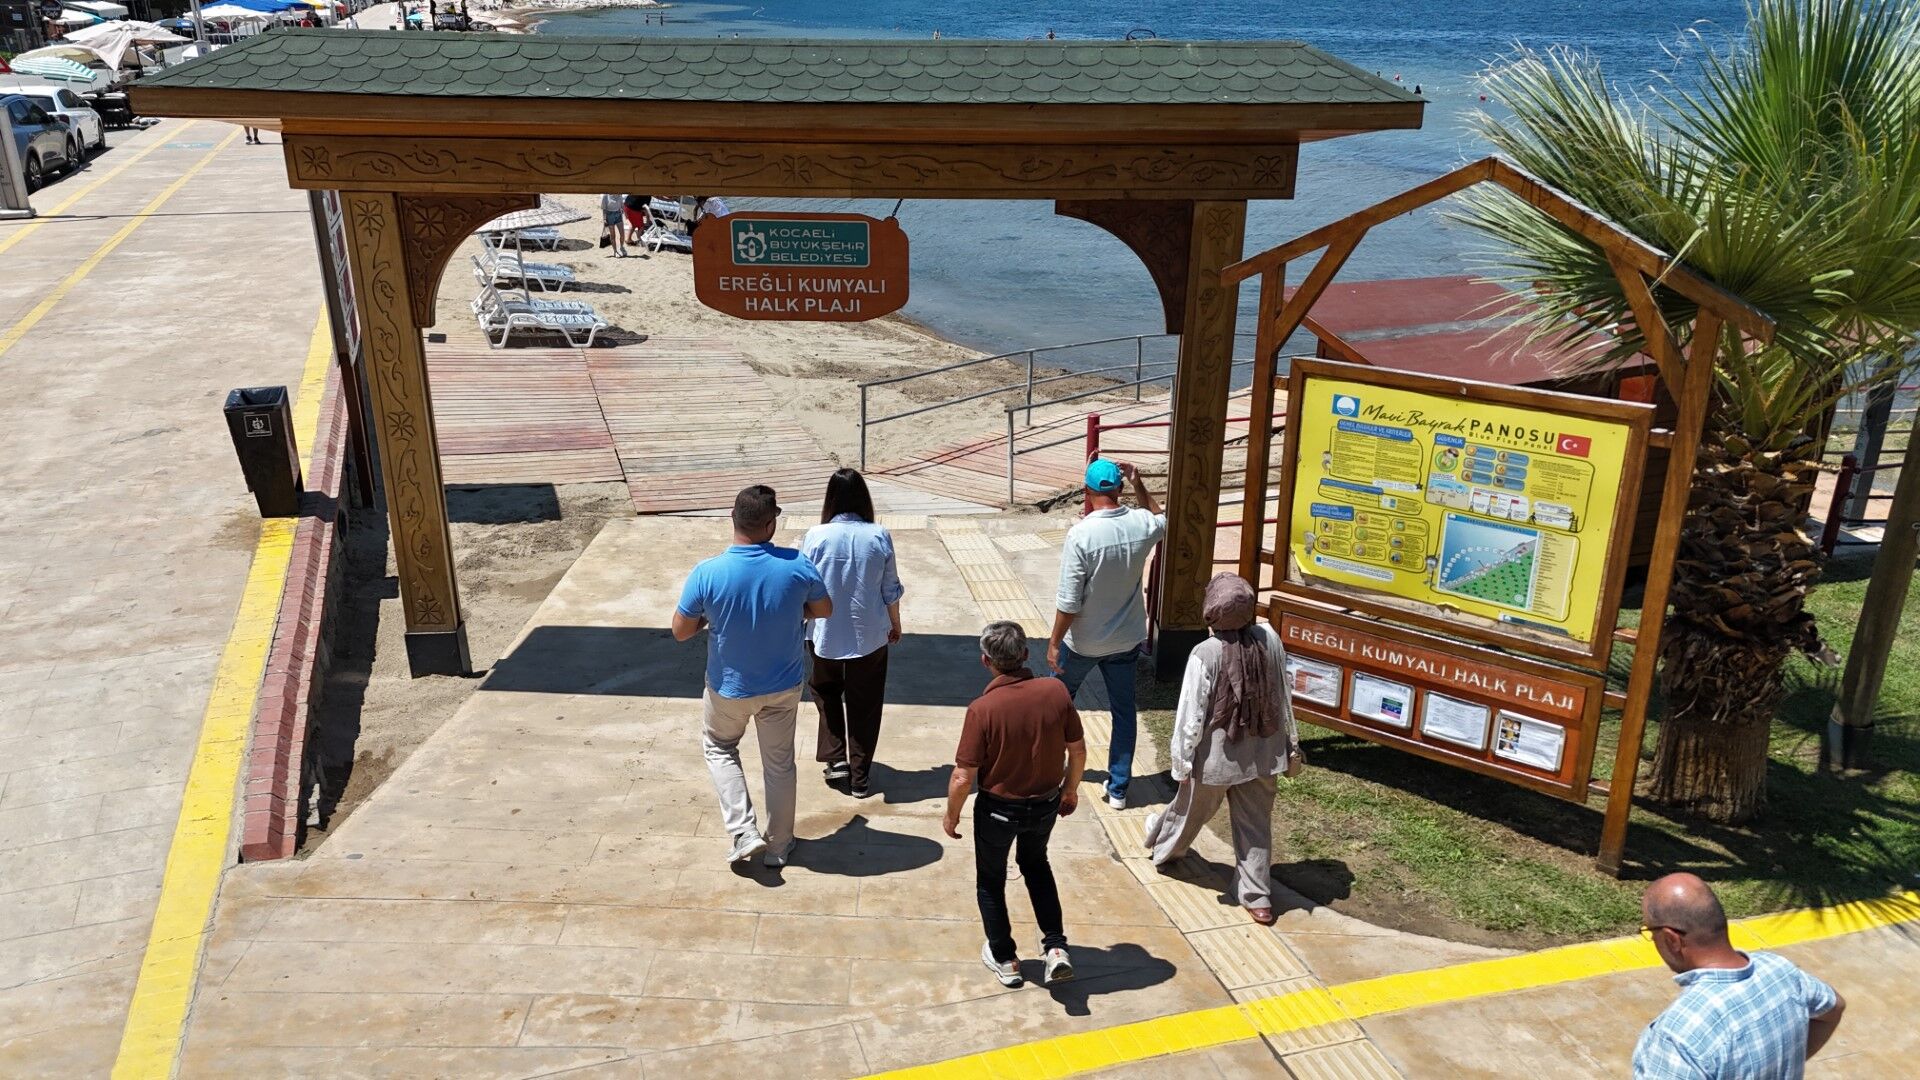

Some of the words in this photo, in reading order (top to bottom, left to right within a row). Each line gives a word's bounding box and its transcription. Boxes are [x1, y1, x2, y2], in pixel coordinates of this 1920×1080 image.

[769, 228, 835, 238] KOCAELİ
[719, 272, 792, 292] EREĞLİ
[799, 278, 886, 294] KUMYALI
[745, 297, 799, 312] HALK
[805, 298, 861, 313] PLAJI
[1362, 404, 1406, 422] Mavi
[1404, 410, 1467, 434] Bayrak
[1470, 419, 1555, 444] PANOSU
[1468, 431, 1490, 441] Blue
[1289, 625, 1355, 653] EREĞLİ
[1362, 644, 1447, 678] KUMYALI
[1453, 668, 1507, 693] HALK
[1515, 683, 1573, 711] PLAJI
